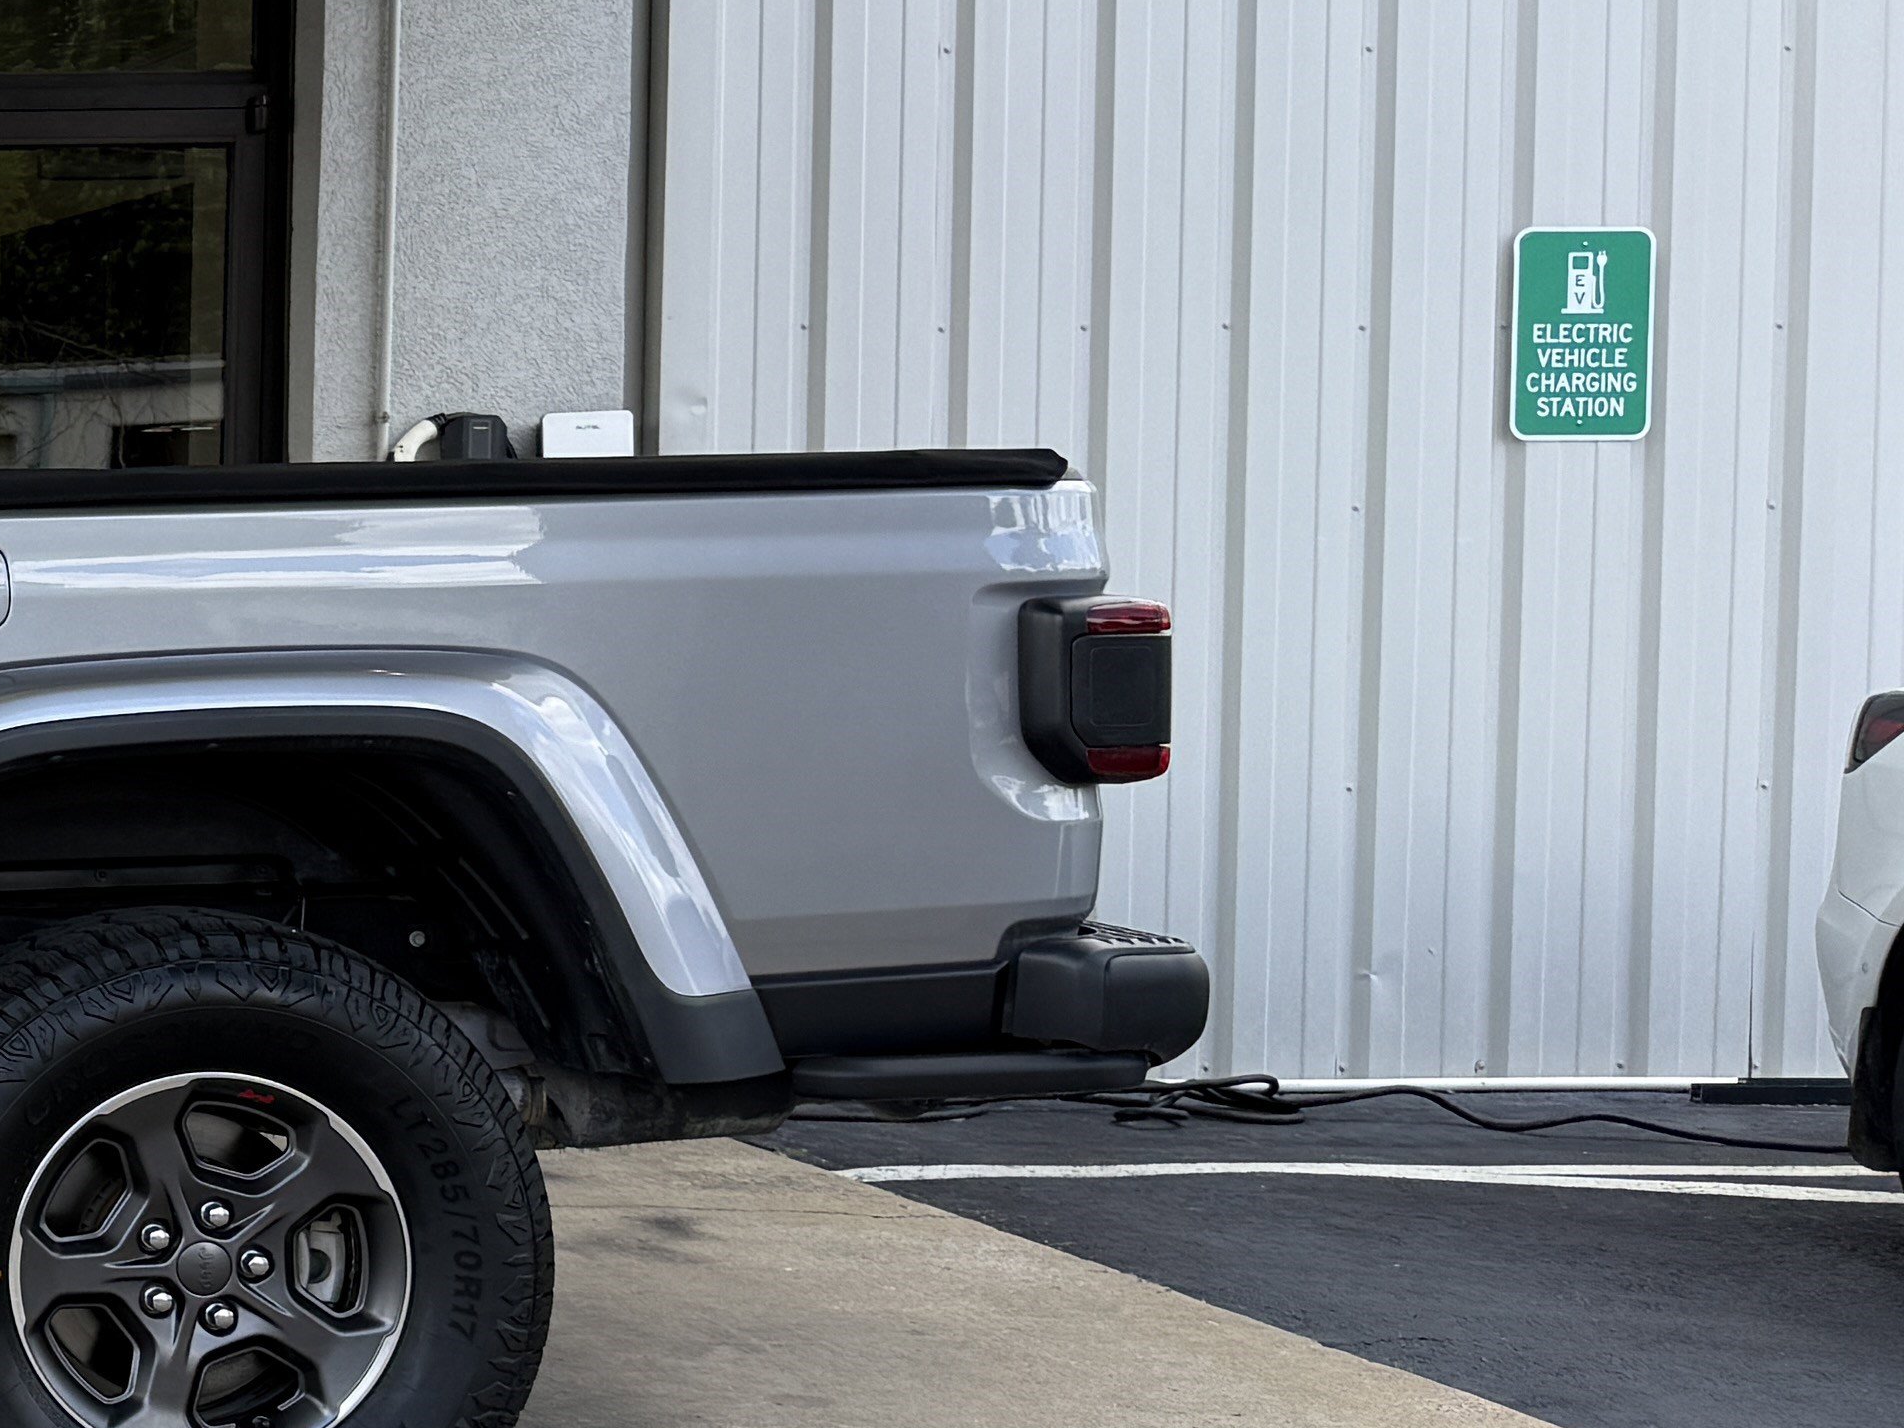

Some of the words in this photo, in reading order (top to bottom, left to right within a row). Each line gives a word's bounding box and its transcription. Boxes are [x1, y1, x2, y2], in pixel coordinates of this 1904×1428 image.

[1533, 323, 1633, 343] ELECTRIC
[1537, 348, 1628, 368] VEHICLE
[1526, 372, 1638, 393] CHARGING
[1537, 397, 1624, 417] STATION
